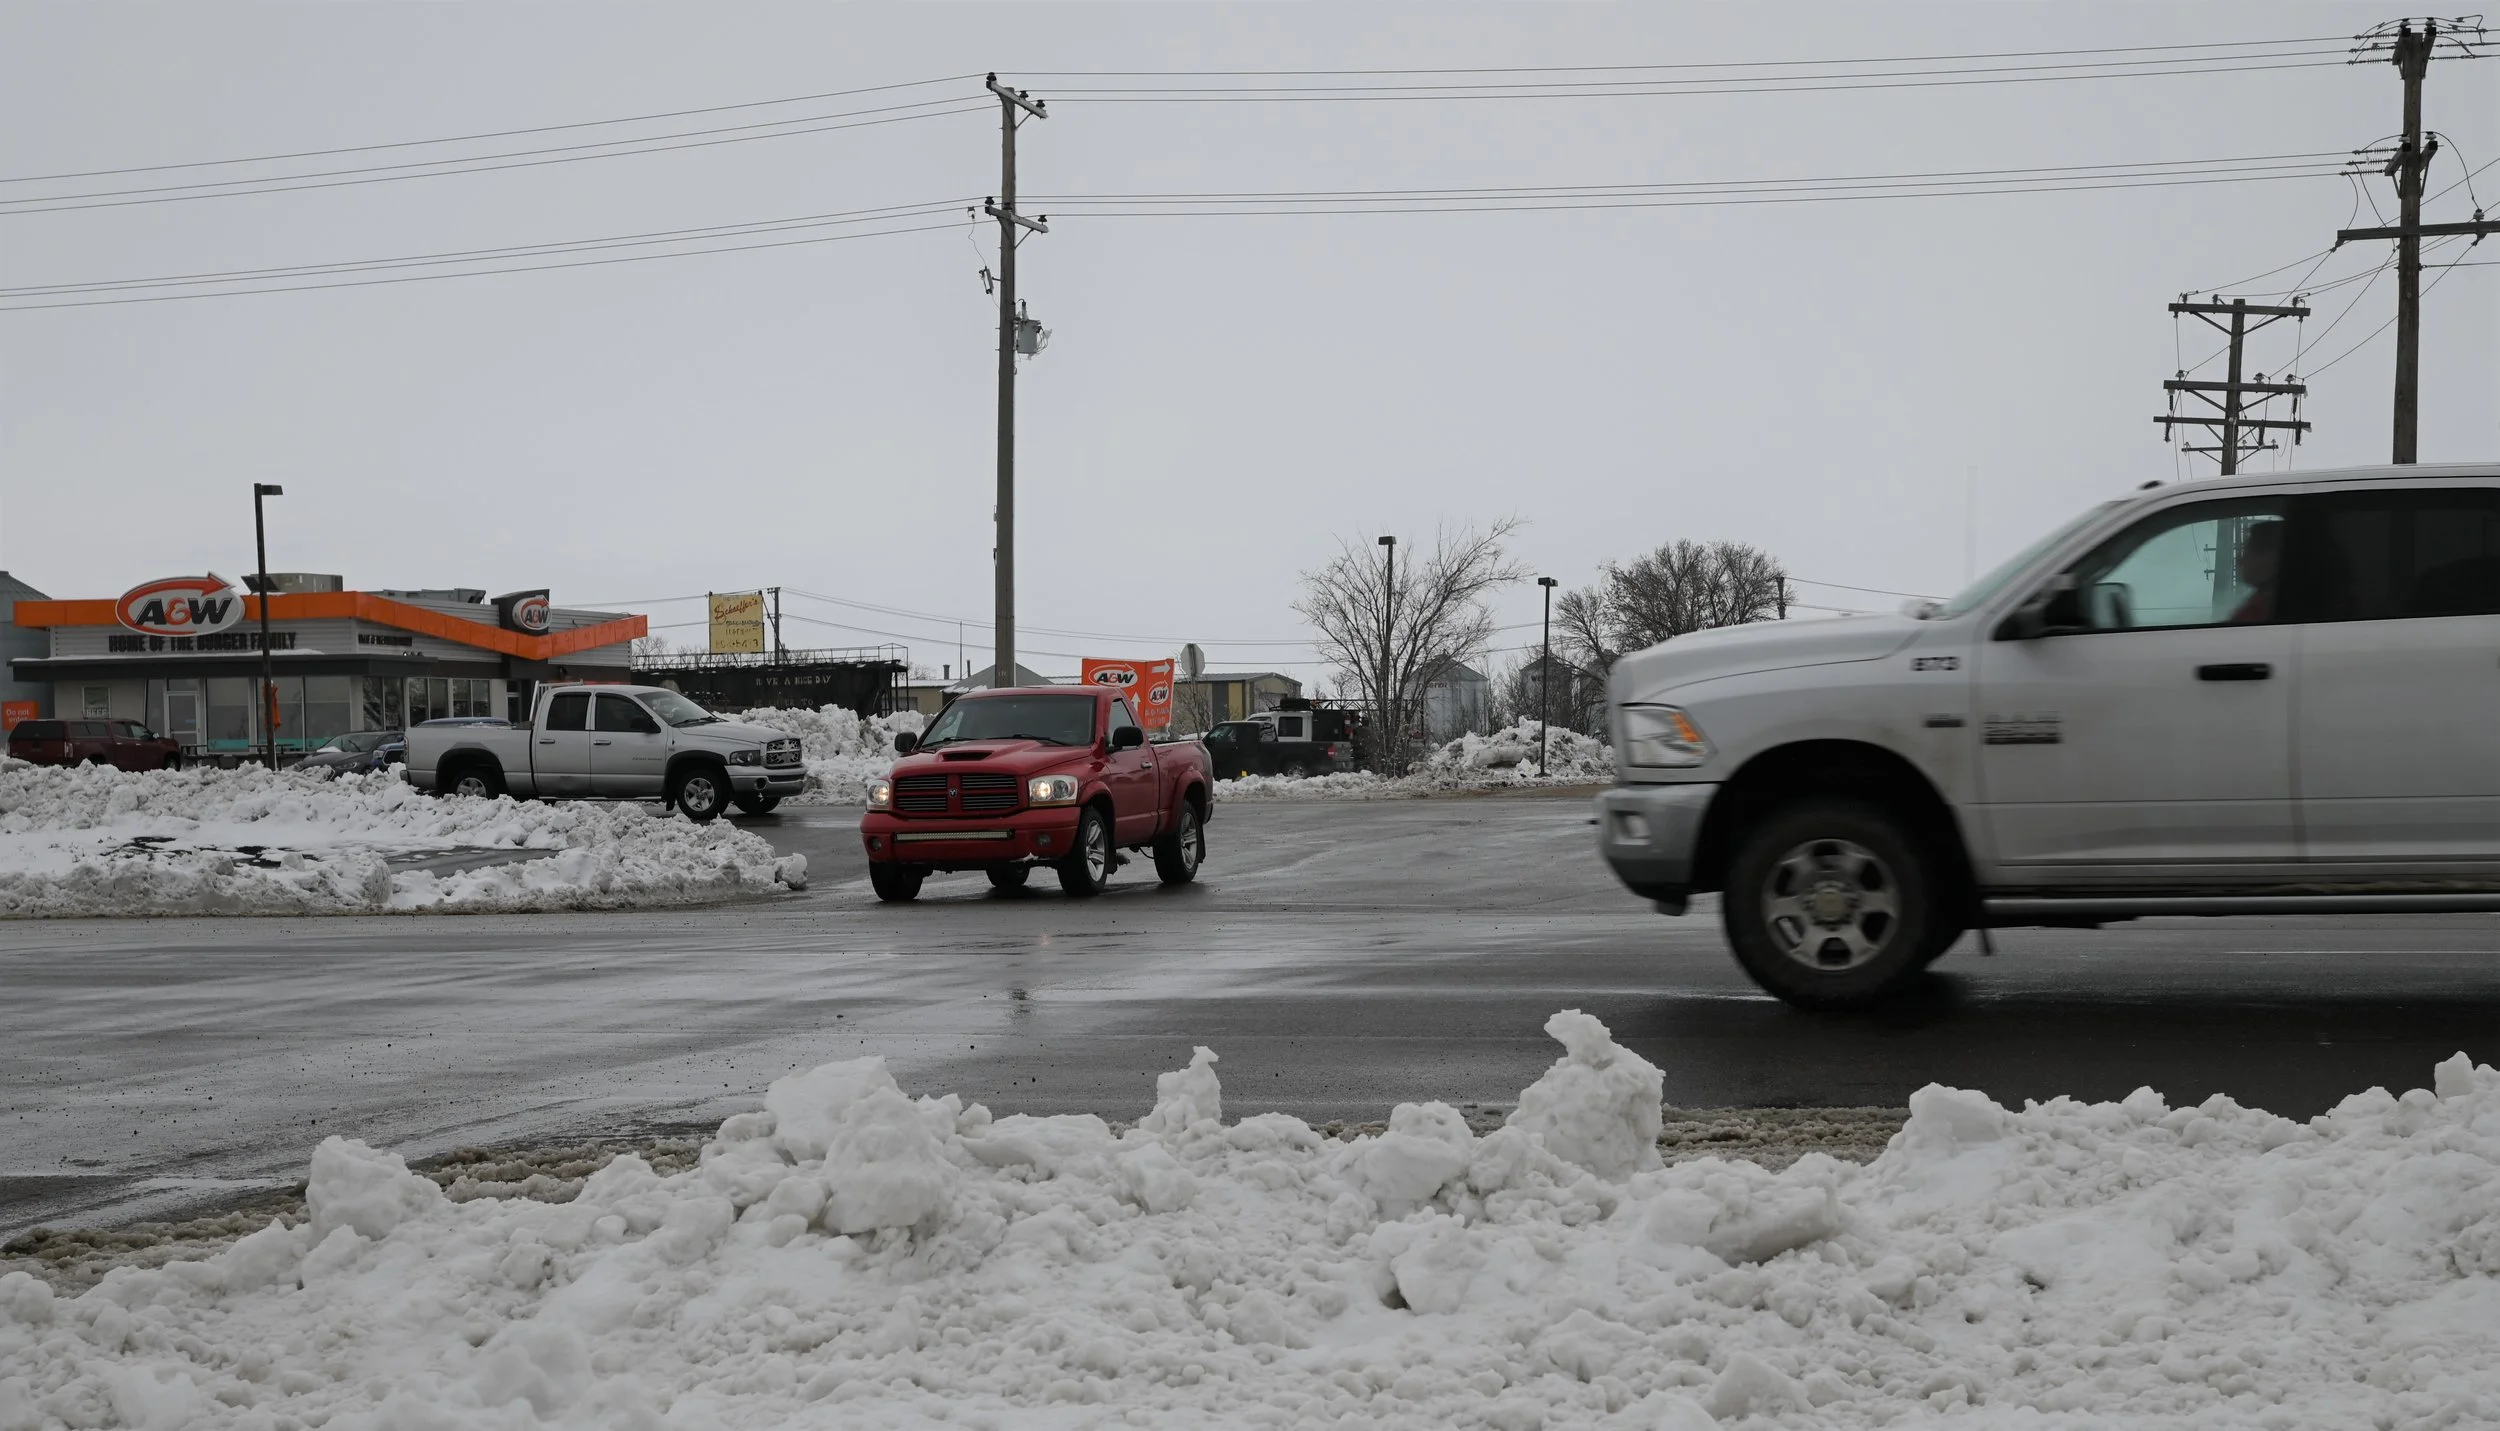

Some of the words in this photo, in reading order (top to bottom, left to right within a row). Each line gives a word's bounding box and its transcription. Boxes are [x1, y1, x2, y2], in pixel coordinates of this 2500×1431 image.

[135, 597, 233, 626] A&W
[525, 608, 548, 624] A&W
[108, 635, 147, 653] HOME
[149, 635, 165, 652] OF
[170, 635, 194, 651] THE
[197, 633, 248, 651] BURGER
[250, 631, 297, 651] FAMILY
[815, 674, 831, 684] DAY
[1096, 672, 1134, 684] A&W
[1151, 689, 1168, 700] A&W
[6, 708, 16, 716] Do
[17, 708, 29, 716] not
